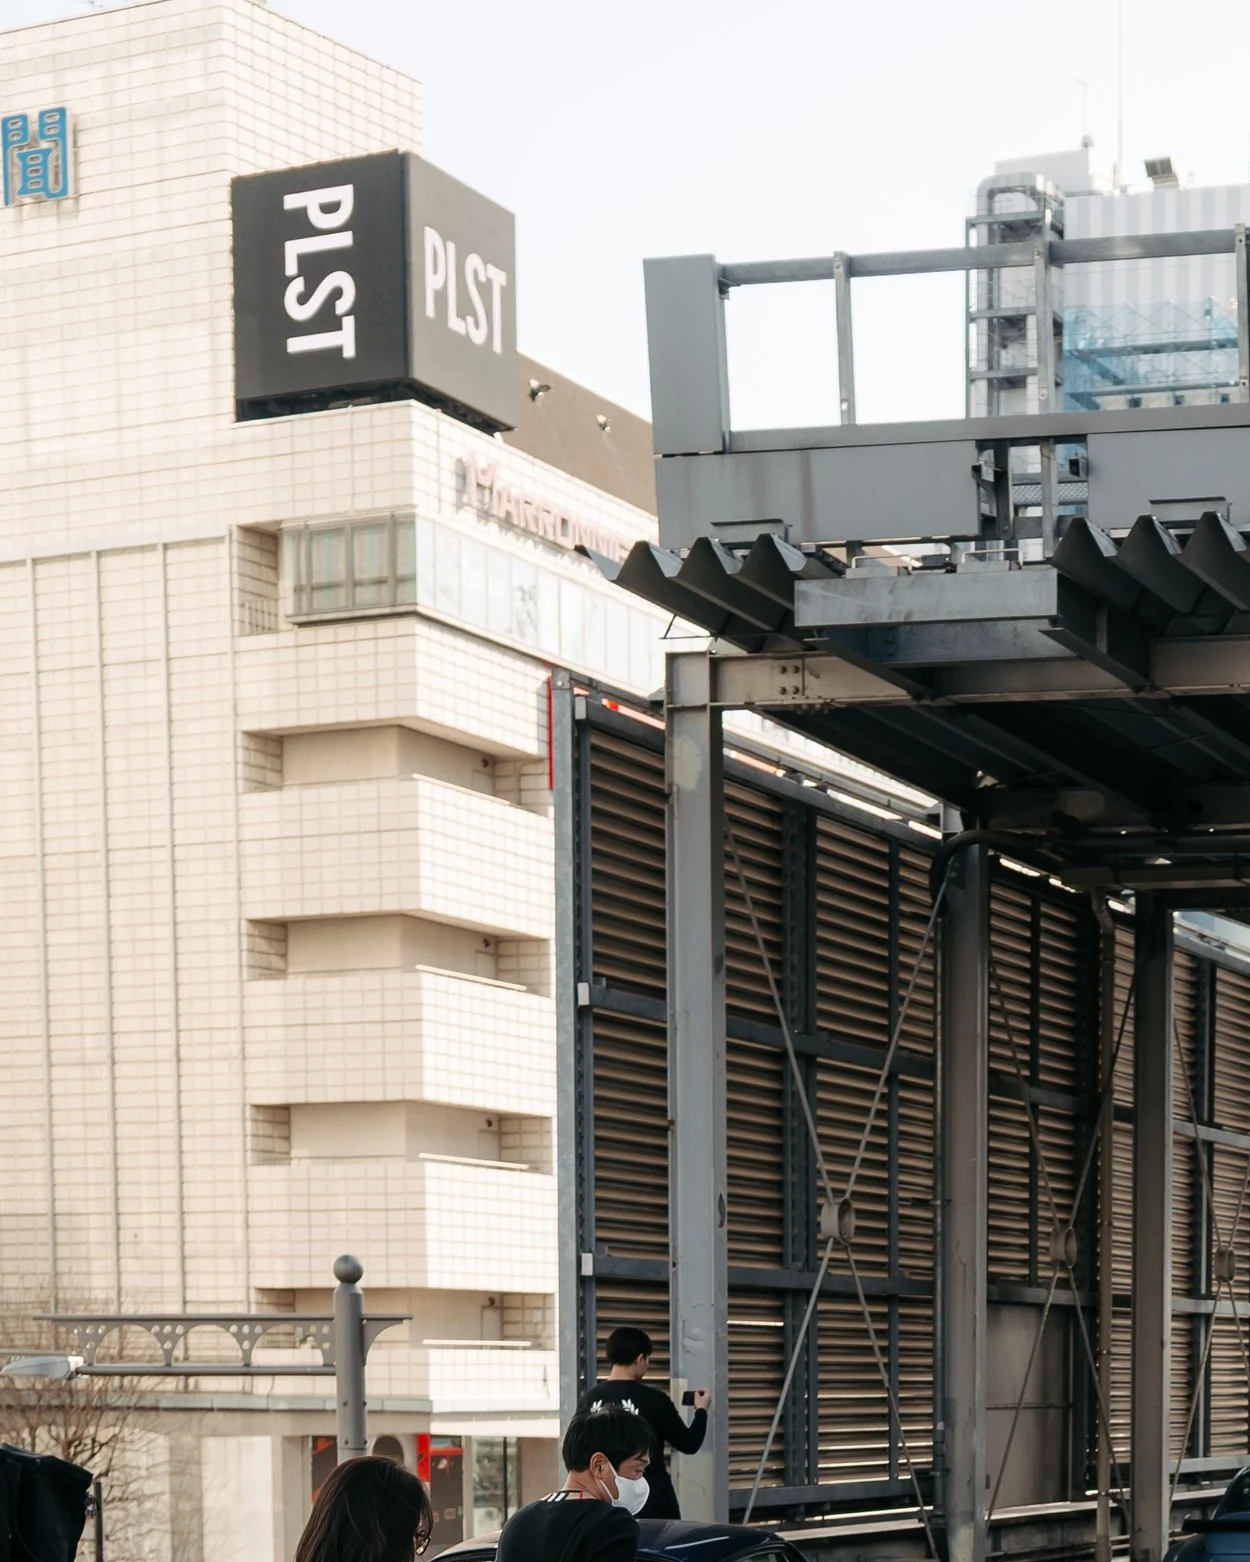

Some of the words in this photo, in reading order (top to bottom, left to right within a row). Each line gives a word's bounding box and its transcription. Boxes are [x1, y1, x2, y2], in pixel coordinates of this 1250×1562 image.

[2, 107, 68, 207] 聞
[283, 184, 356, 360] PLST
[424, 226, 507, 355] PLST
